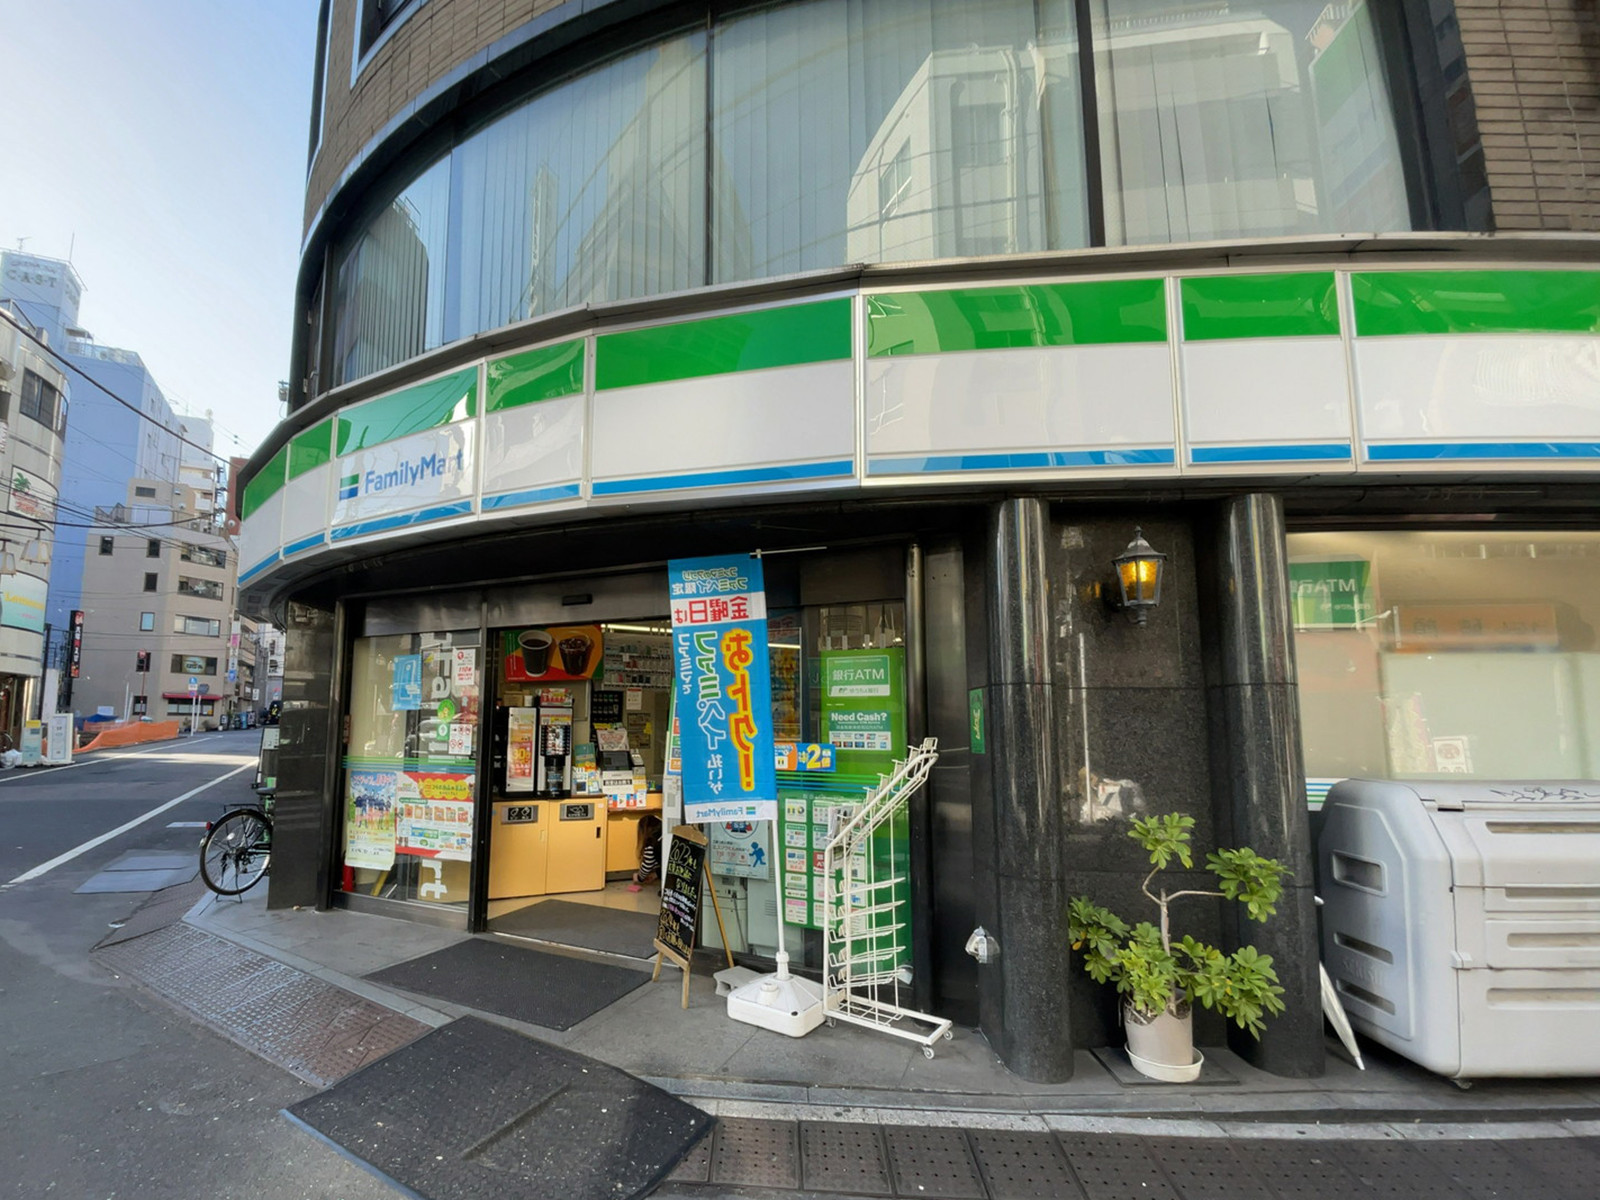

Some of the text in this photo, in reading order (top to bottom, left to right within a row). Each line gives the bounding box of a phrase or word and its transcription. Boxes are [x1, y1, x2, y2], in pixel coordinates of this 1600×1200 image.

[364, 448, 464, 494] FamilyMart
[832, 668, 885, 682] 銀行ATM
[831, 712, 887, 722] Need Cash?
